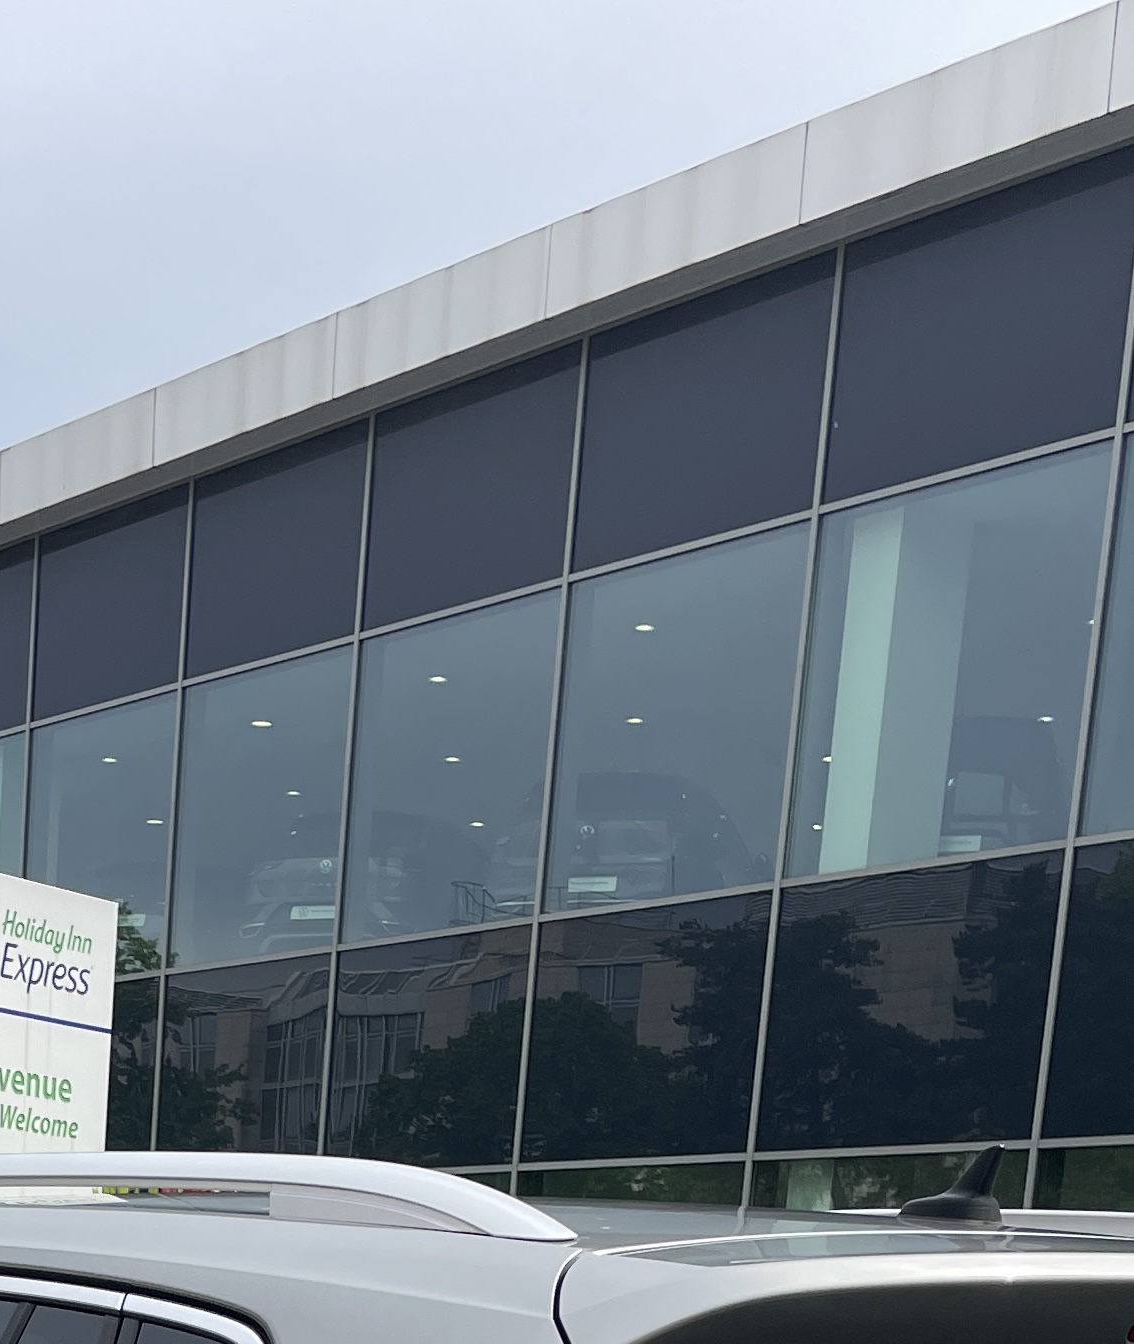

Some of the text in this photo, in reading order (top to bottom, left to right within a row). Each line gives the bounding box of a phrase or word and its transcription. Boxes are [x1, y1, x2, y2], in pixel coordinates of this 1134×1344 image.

[2, 909, 92, 954] Holiday Inn
[0, 942, 91, 995] Express
[0, 1104, 79, 1139] Welcome
